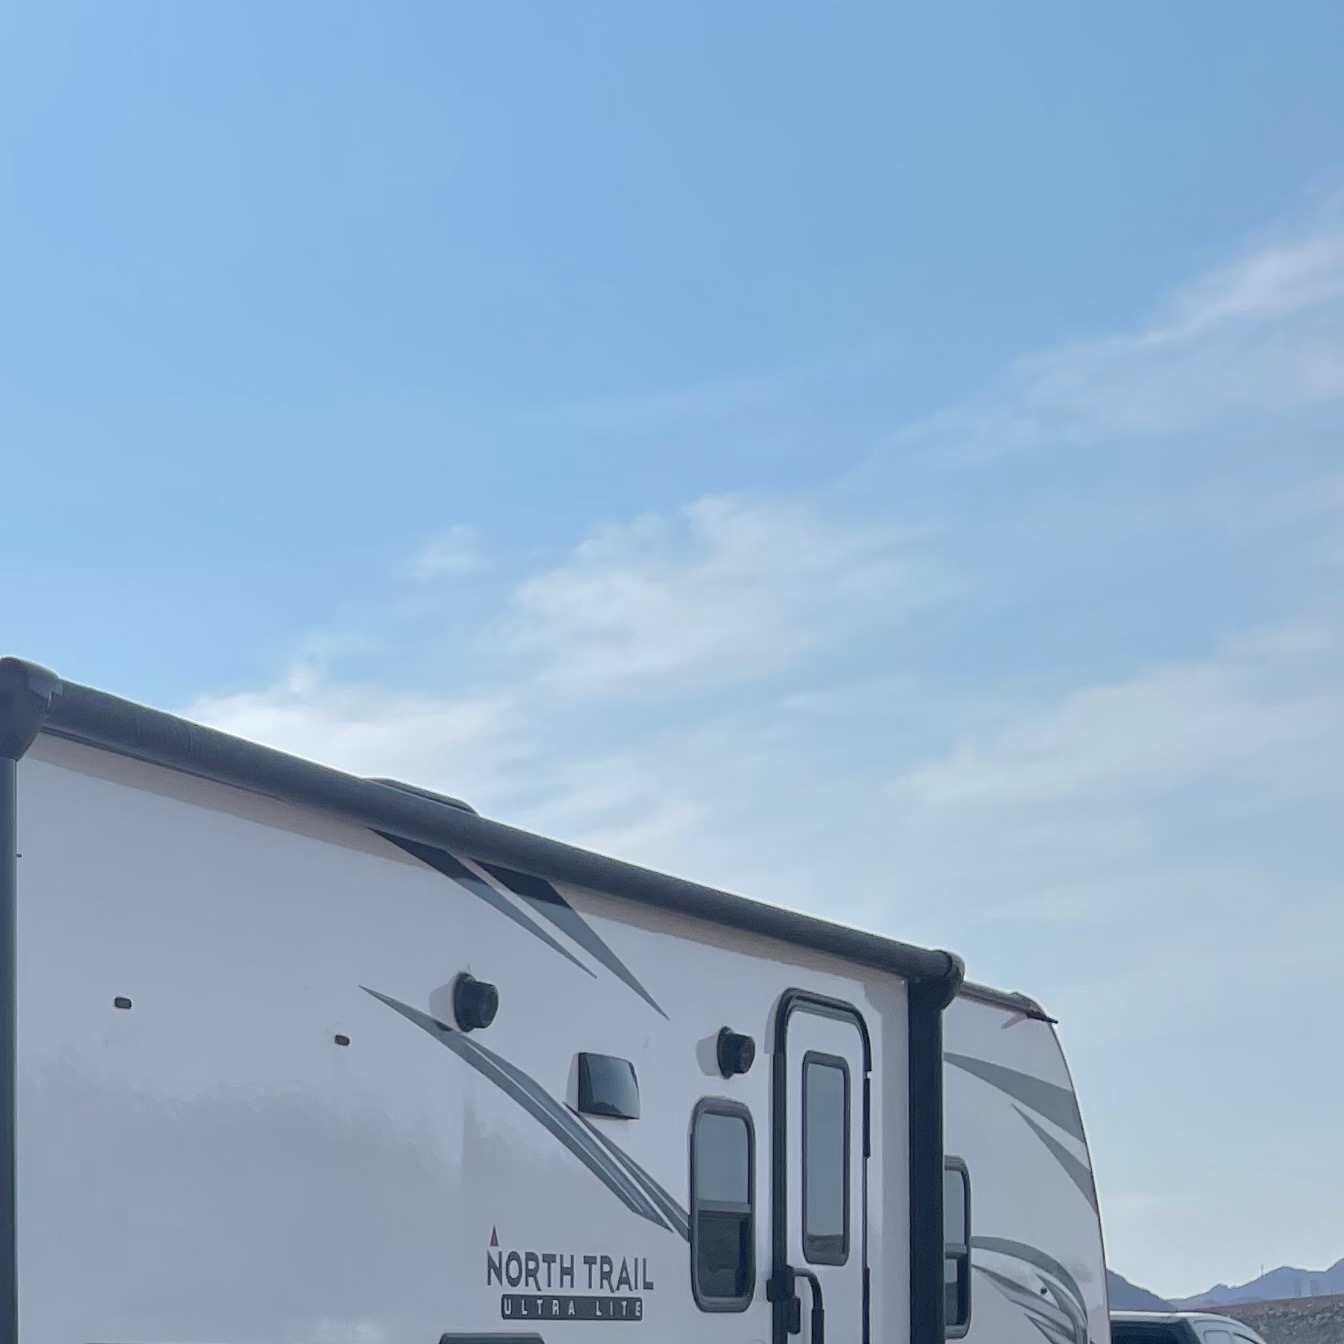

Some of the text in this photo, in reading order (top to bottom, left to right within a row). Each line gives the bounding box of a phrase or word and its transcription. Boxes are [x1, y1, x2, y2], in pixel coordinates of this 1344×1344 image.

[486, 1249, 654, 1293] NORTH TRAIL
[503, 1298, 641, 1317] ULTRA LITE
